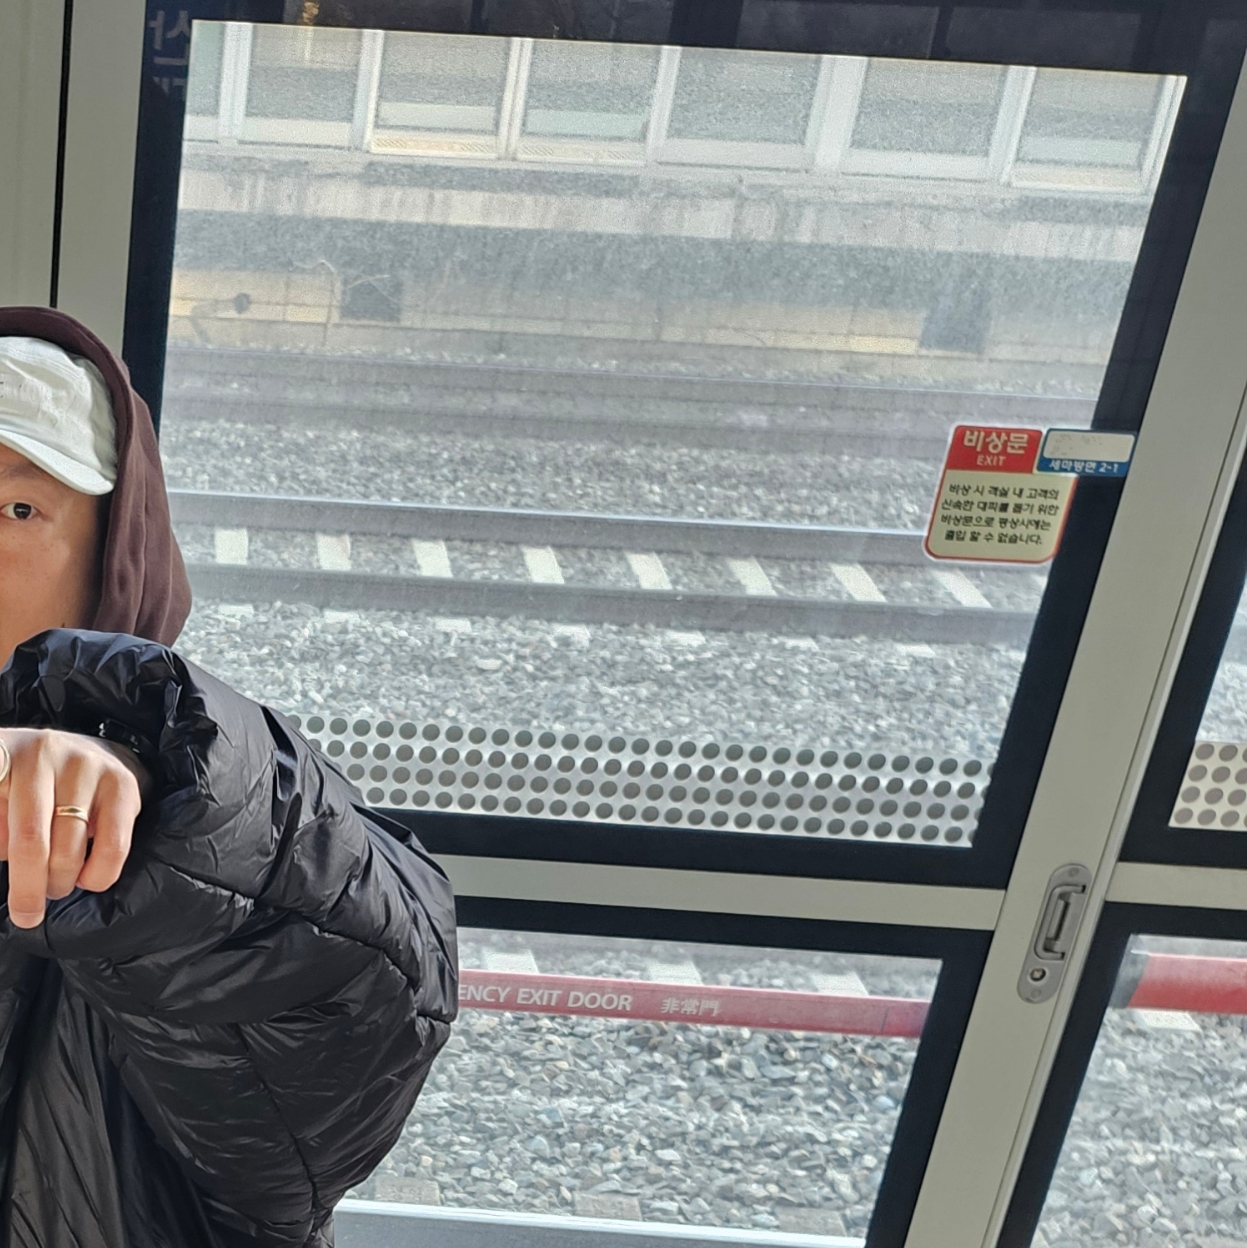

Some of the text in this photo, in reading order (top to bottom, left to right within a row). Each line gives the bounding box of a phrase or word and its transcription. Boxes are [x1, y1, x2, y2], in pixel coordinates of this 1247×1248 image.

[963, 430, 1029, 454] 비상문
[976, 455, 1006, 467] EXIT
[1049, 459, 1119, 473] 세마방면 2-1
[949, 484, 972, 497] 비상
[973, 485, 985, 497] 시
[1012, 486, 1024, 499] 내
[458, 984, 633, 1011] ENCY EXIT DOOR
[660, 997, 719, 1017] 非常門
